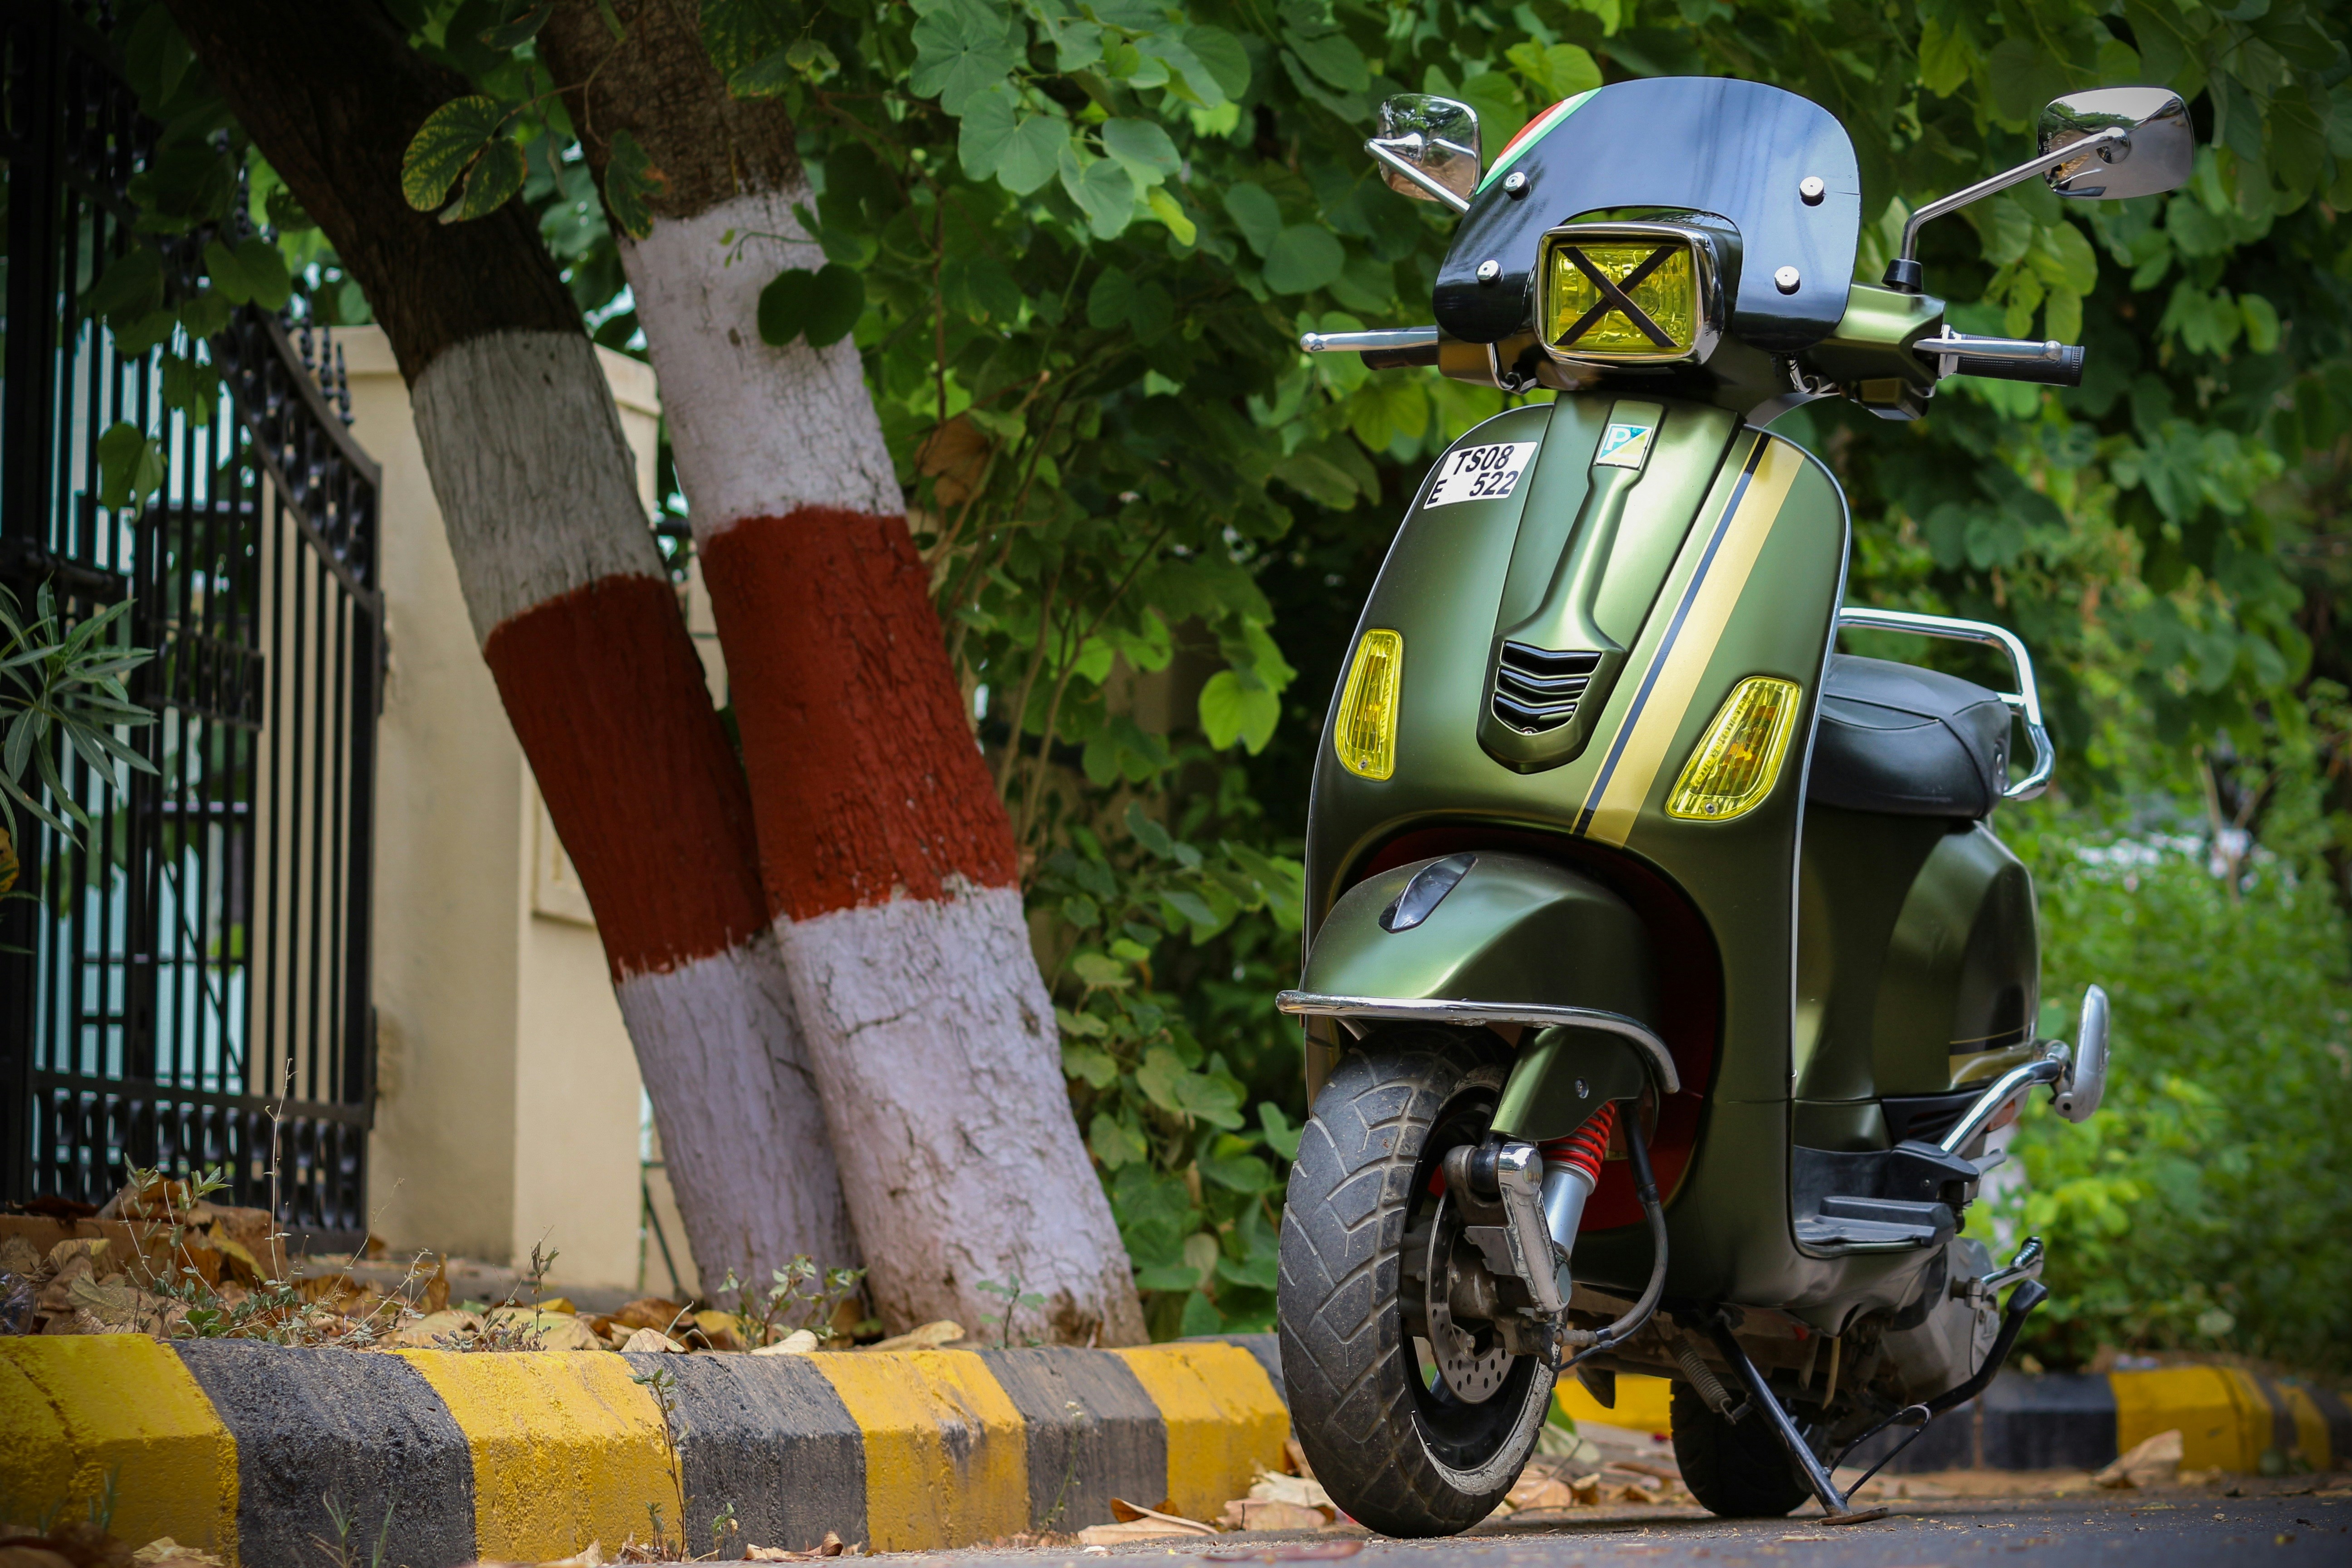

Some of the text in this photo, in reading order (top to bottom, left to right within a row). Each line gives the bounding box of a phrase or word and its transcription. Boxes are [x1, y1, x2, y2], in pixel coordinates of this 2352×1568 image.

[1604, 427, 1631, 451] P
[1453, 445, 1515, 475] TS08
[1426, 470, 1519, 505] E 522
